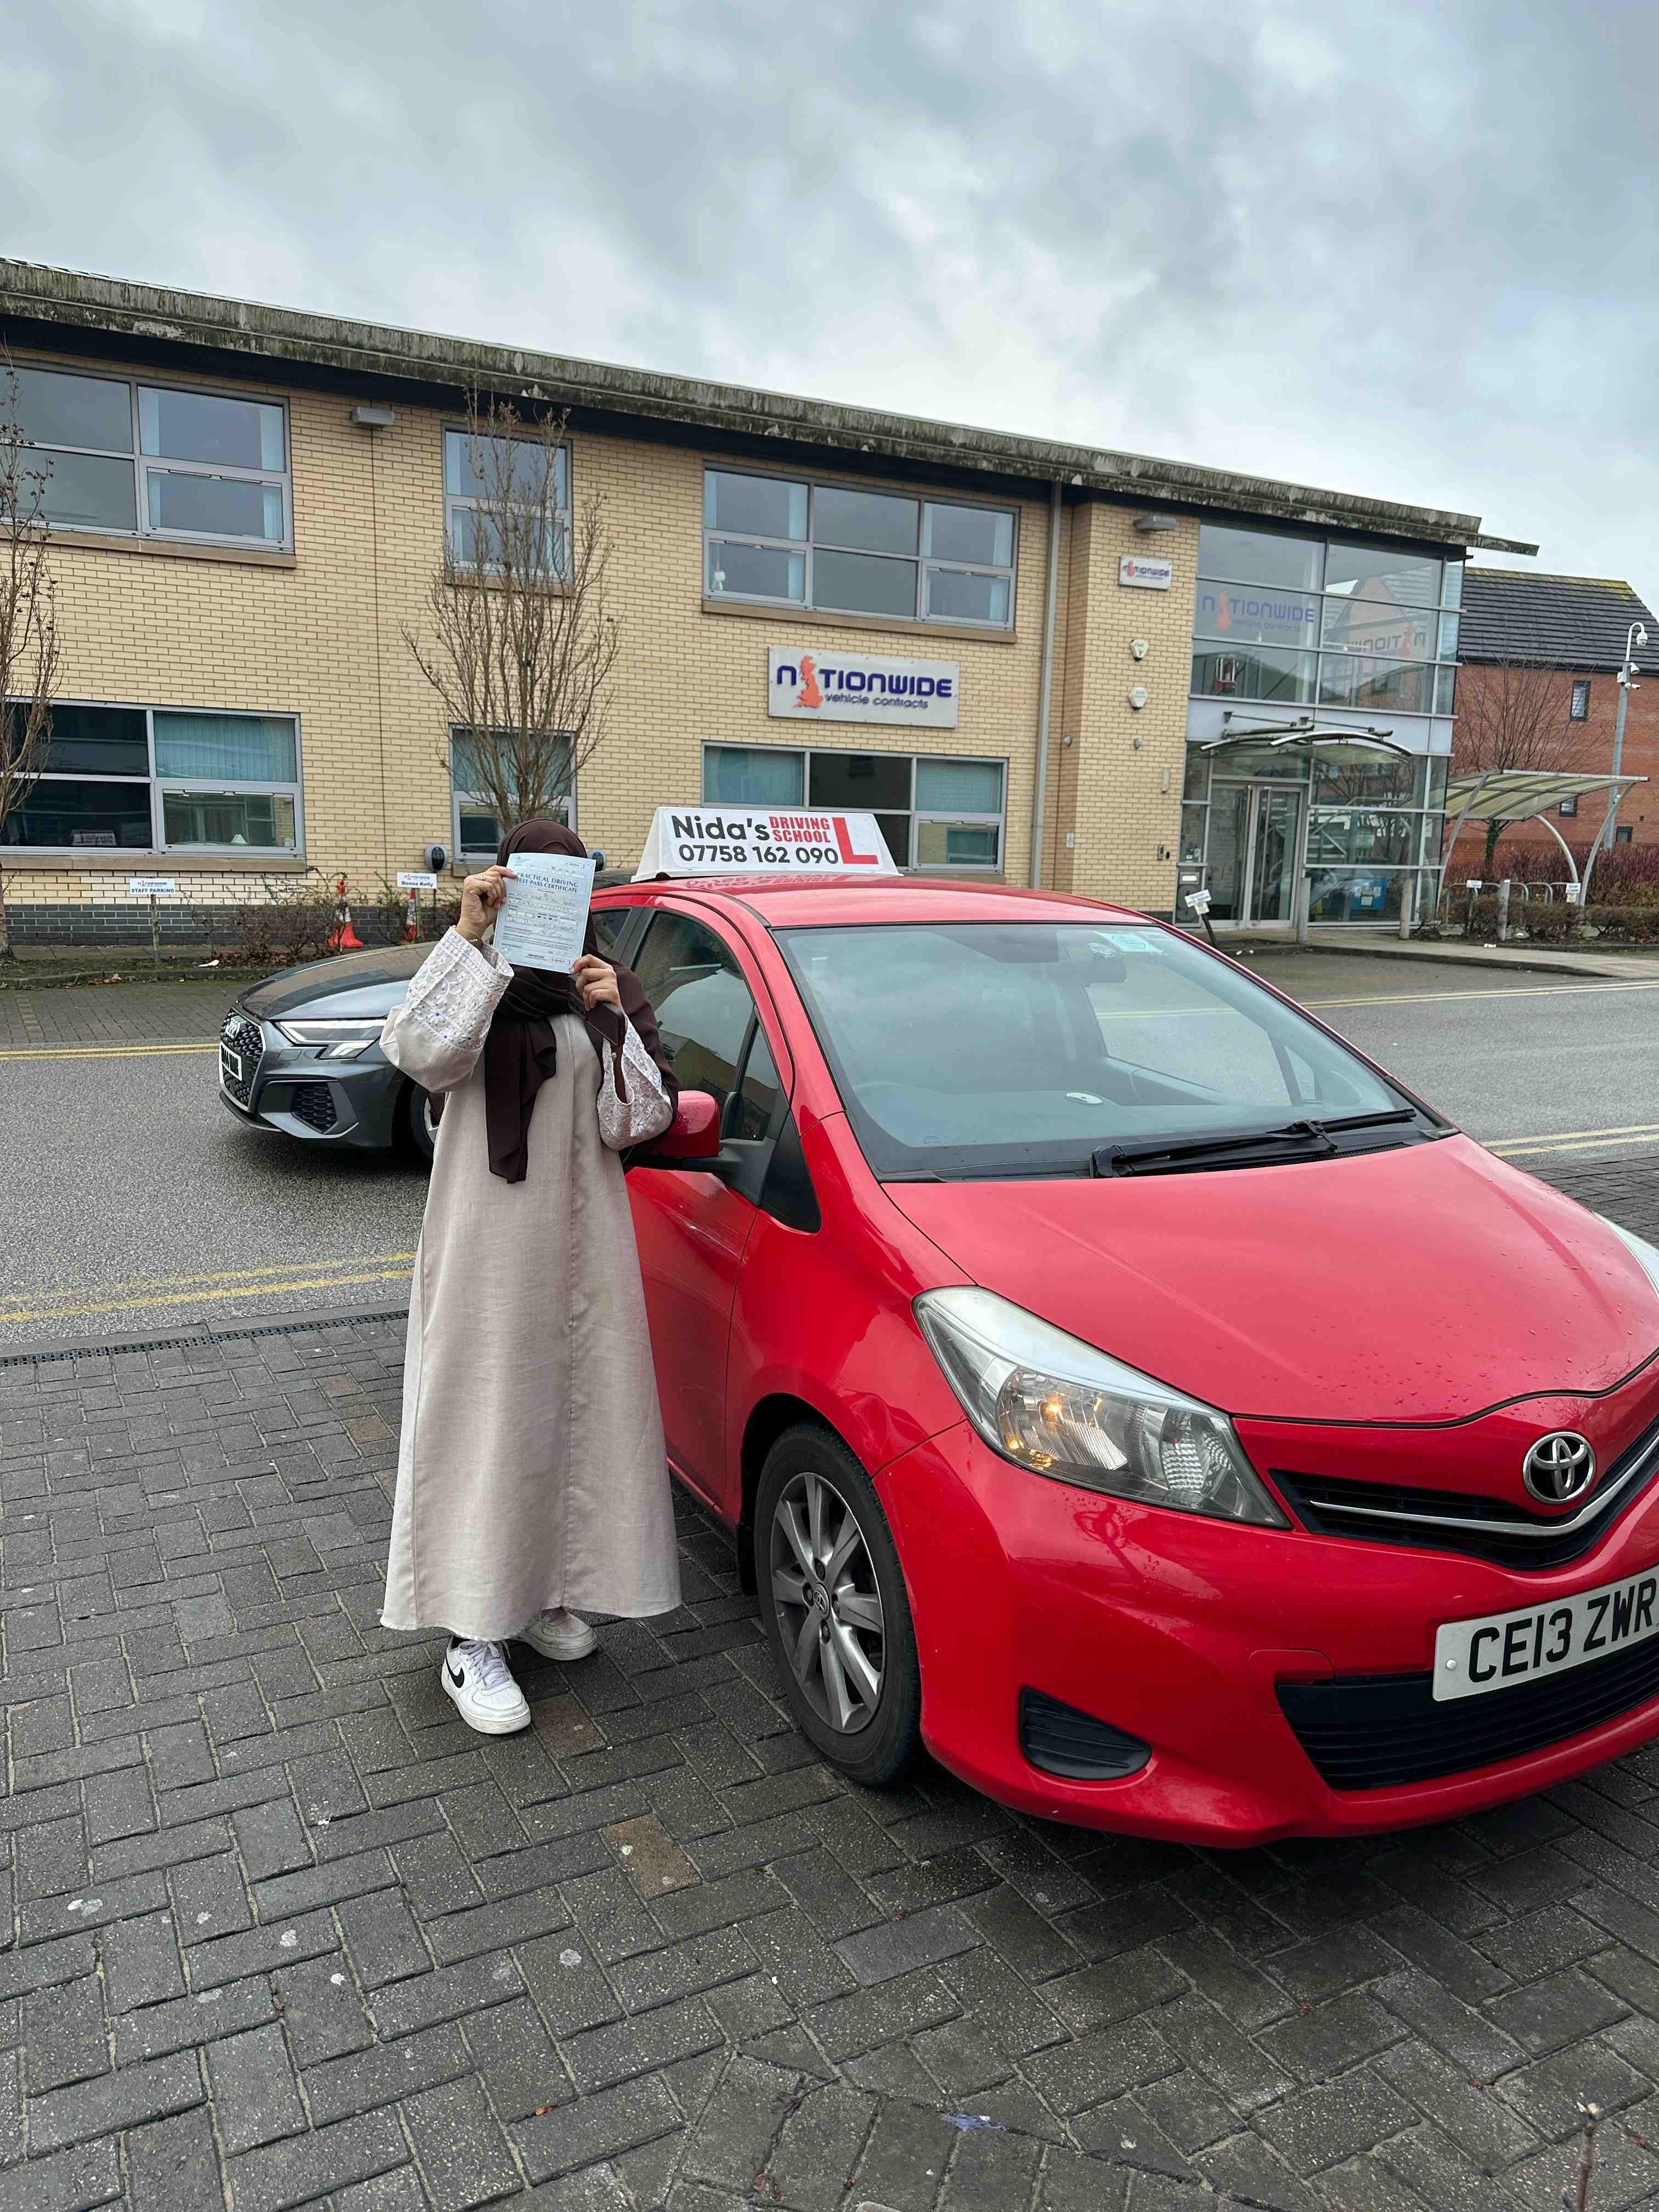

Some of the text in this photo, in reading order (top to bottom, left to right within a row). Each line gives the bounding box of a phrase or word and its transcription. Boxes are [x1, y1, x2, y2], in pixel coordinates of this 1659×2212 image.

[825, 693, 929, 709] vehicle contracts
[671, 815, 769, 840] Nida's
[769, 816, 830, 830] DRIVING
[772, 830, 831, 843] SCHOOL
[832, 817, 879, 865] L
[679, 844, 838, 864] 07758 162 090
[517, 872, 579, 888] PRACTICAL DRIVING
[544, 883, 579, 893] CERTIFICATE
[1469, 1578, 1657, 1683] CE13 ZWR
